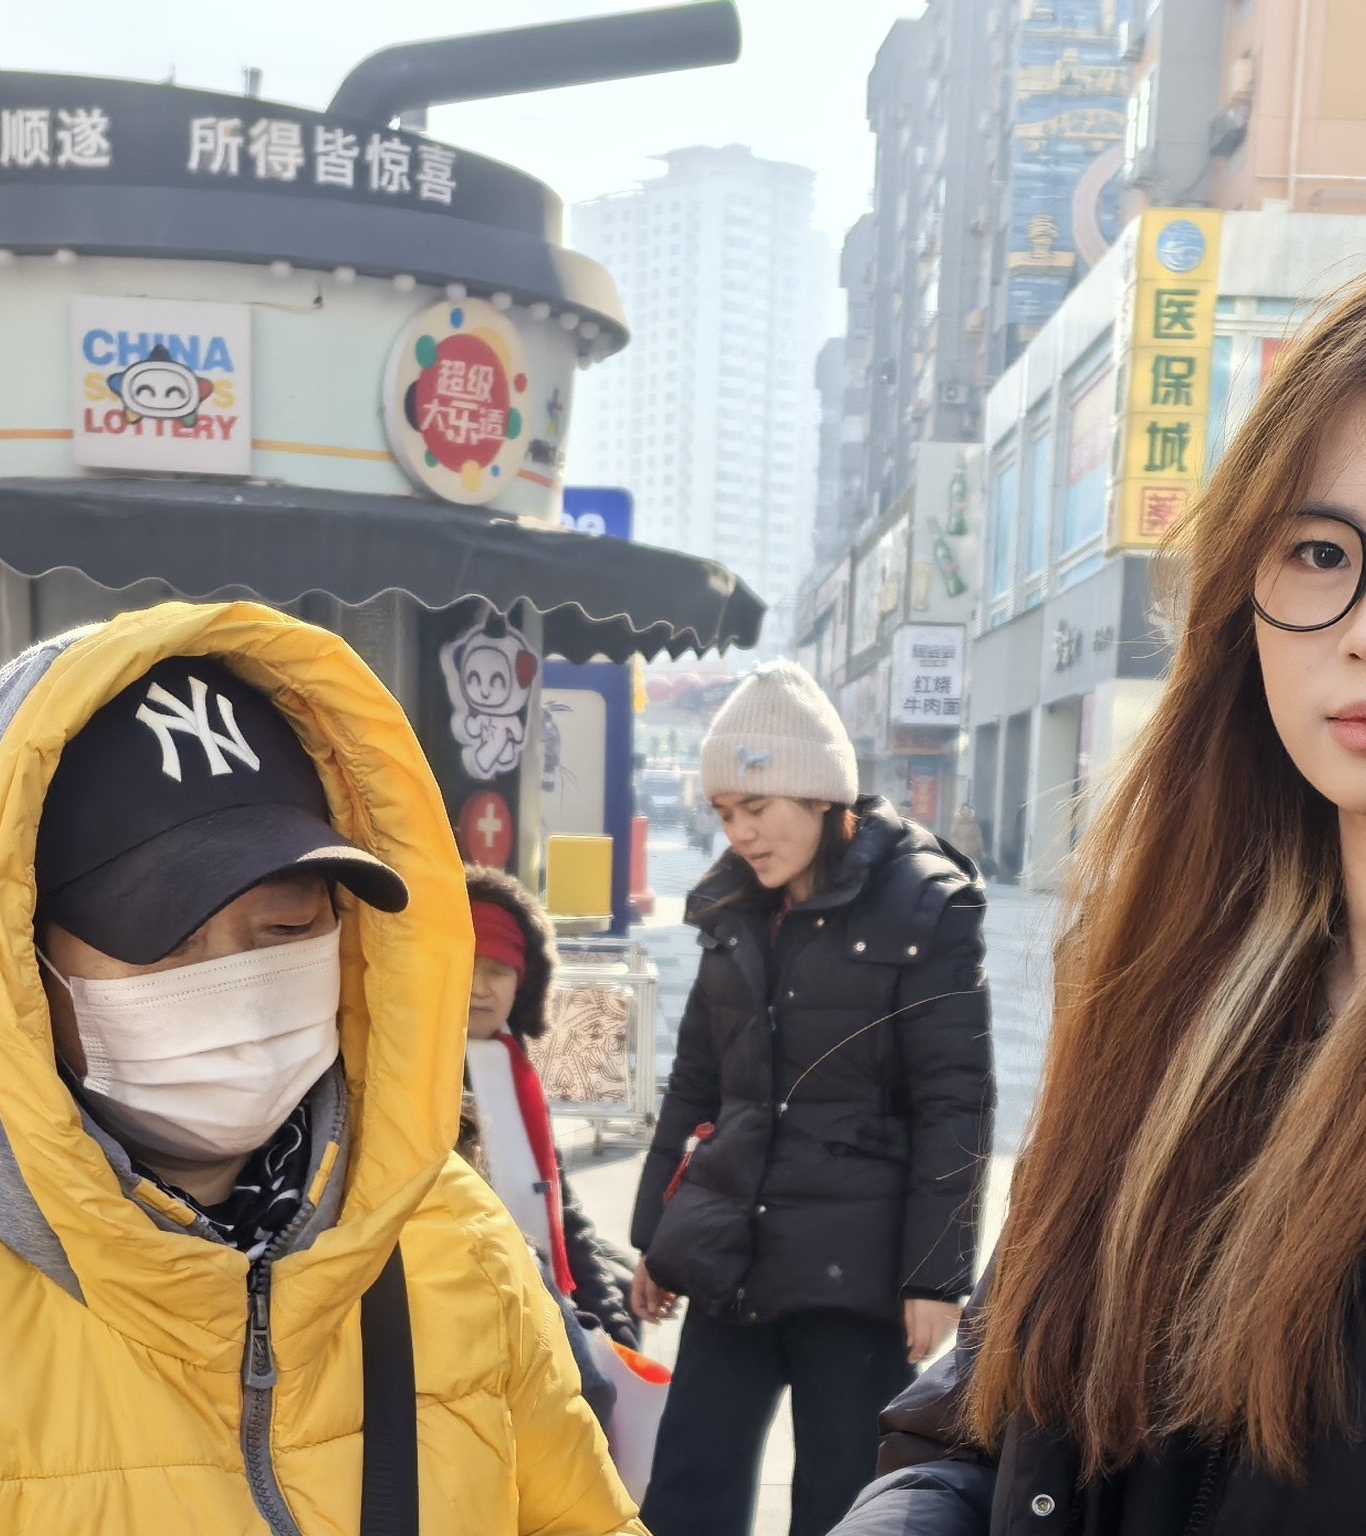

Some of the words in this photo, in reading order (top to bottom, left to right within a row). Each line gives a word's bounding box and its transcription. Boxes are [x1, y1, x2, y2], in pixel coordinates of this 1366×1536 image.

[187, 115, 457, 206] 所得皆惊喜
[436, 359, 496, 404] 超级
[1144, 288, 1199, 473] 医保城
[420, 397, 508, 445] 大乐透
[902, 697, 960, 716] 牛肉面
[913, 675, 952, 694] 红烧
[135, 676, 261, 783] NY
